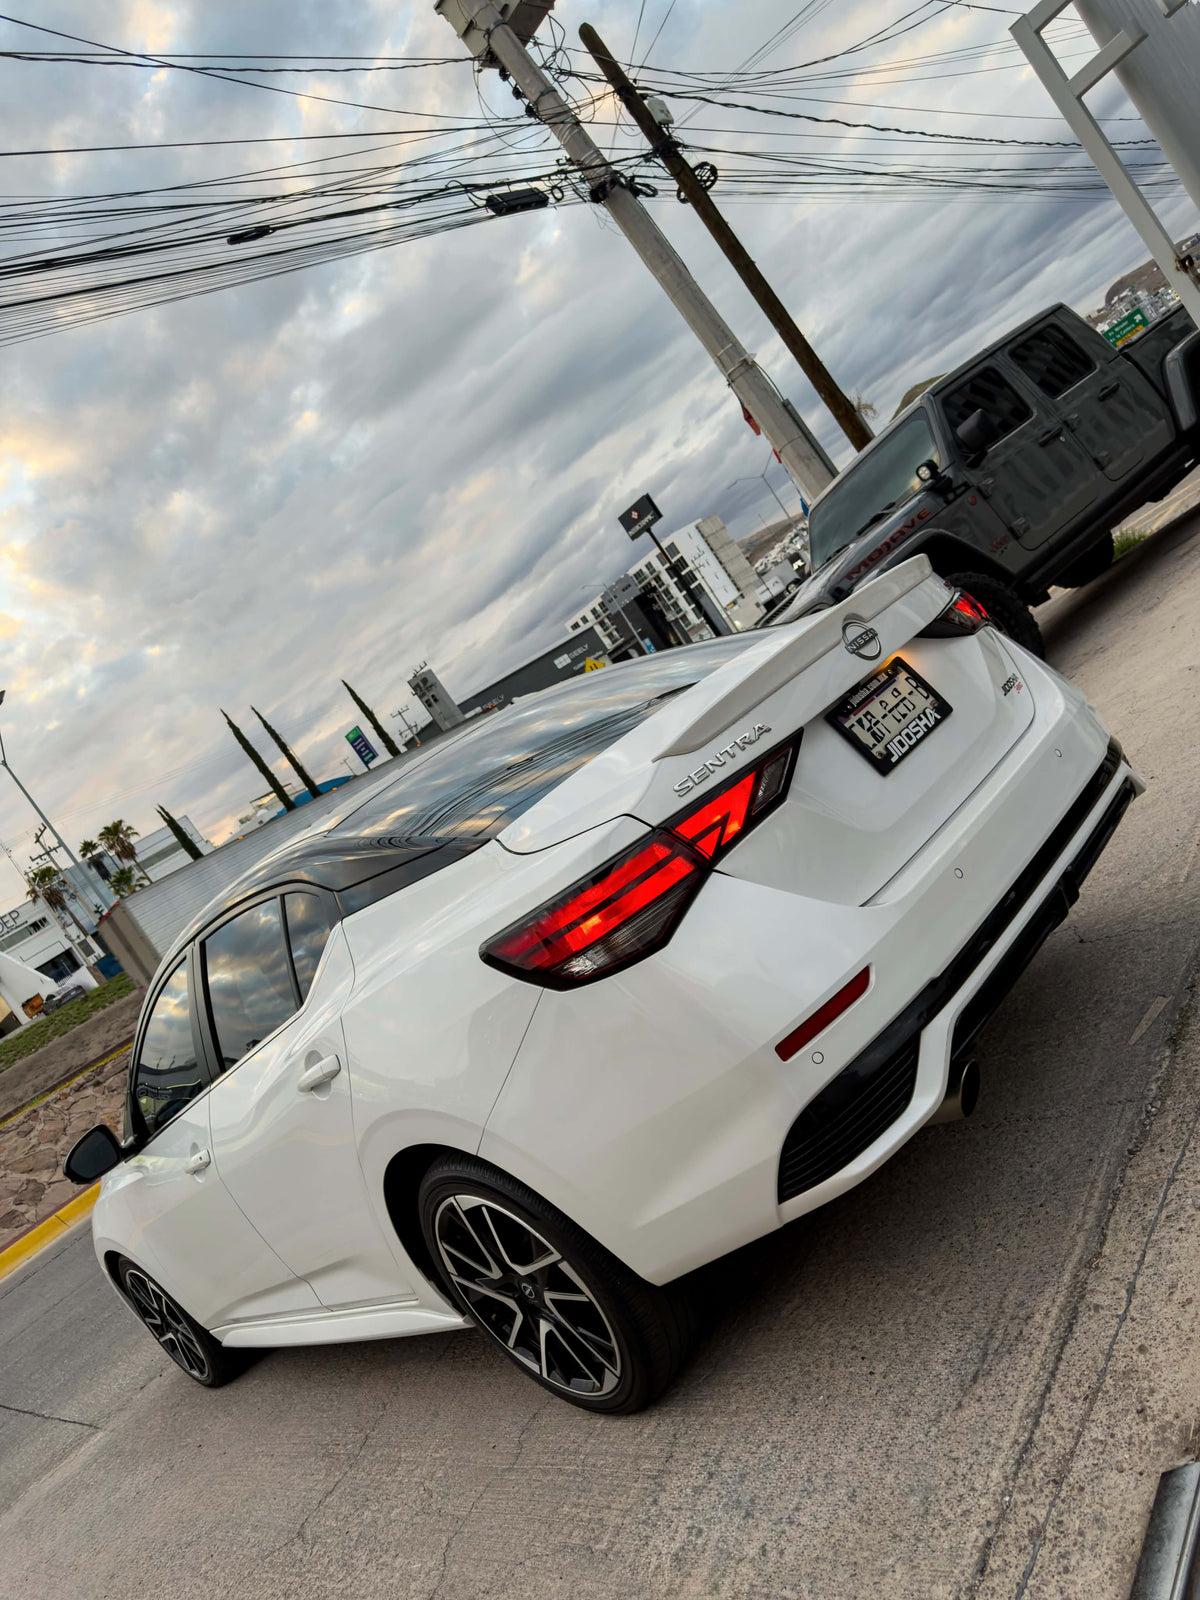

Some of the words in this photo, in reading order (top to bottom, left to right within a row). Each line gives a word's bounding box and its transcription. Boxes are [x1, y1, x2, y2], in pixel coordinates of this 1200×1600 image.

[843, 508, 932, 582] MOJAVE
[848, 629, 878, 651] NISSAN
[673, 723, 772, 797] SENTRA
[886, 707, 942, 763] JIDOSHA
